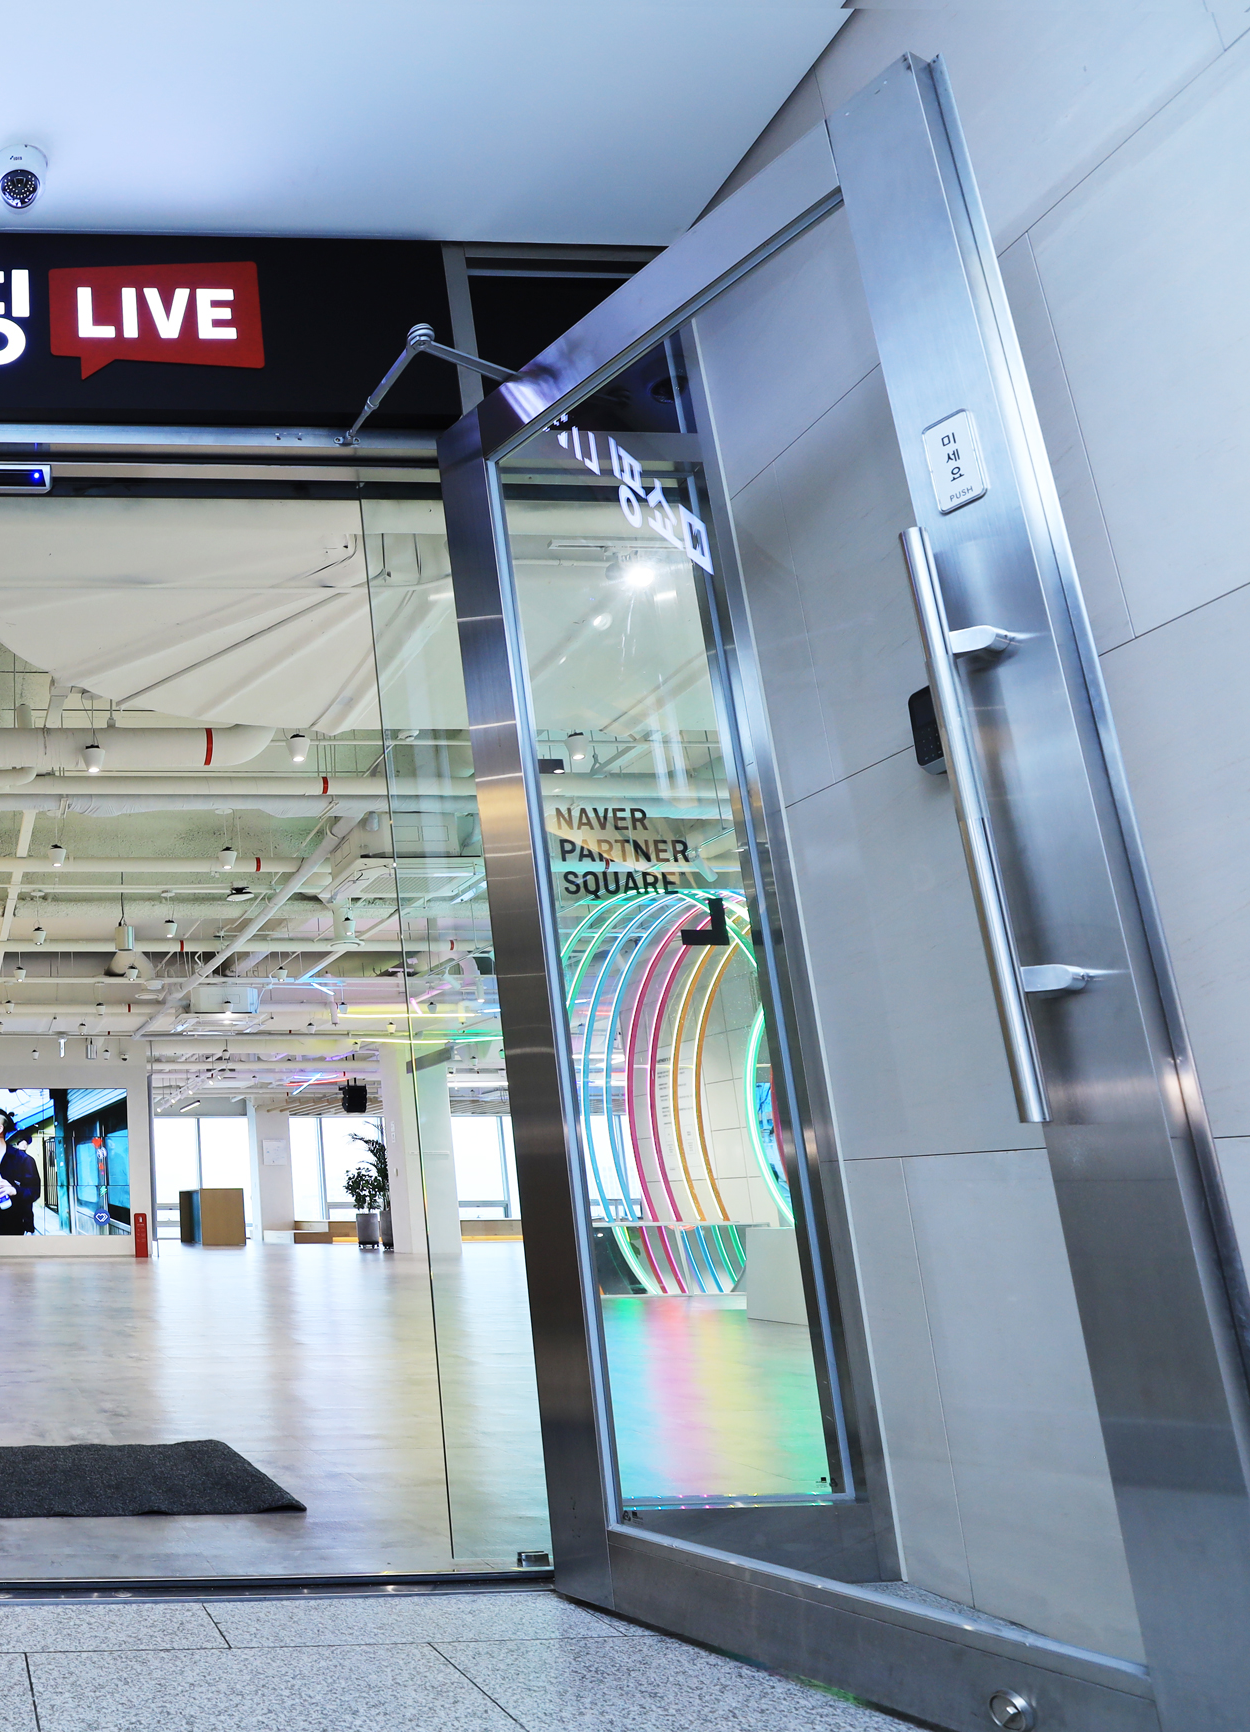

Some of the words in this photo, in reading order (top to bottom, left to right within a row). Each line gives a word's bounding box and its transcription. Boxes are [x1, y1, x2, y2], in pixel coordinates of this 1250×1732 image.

[76, 286, 237, 340] LIVE
[941, 432, 965, 482] 미세요
[949, 485, 974, 502] PUSH
[554, 807, 648, 831] NAVER
[560, 839, 690, 863] PARTNER
[564, 871, 678, 899] SQUARE
